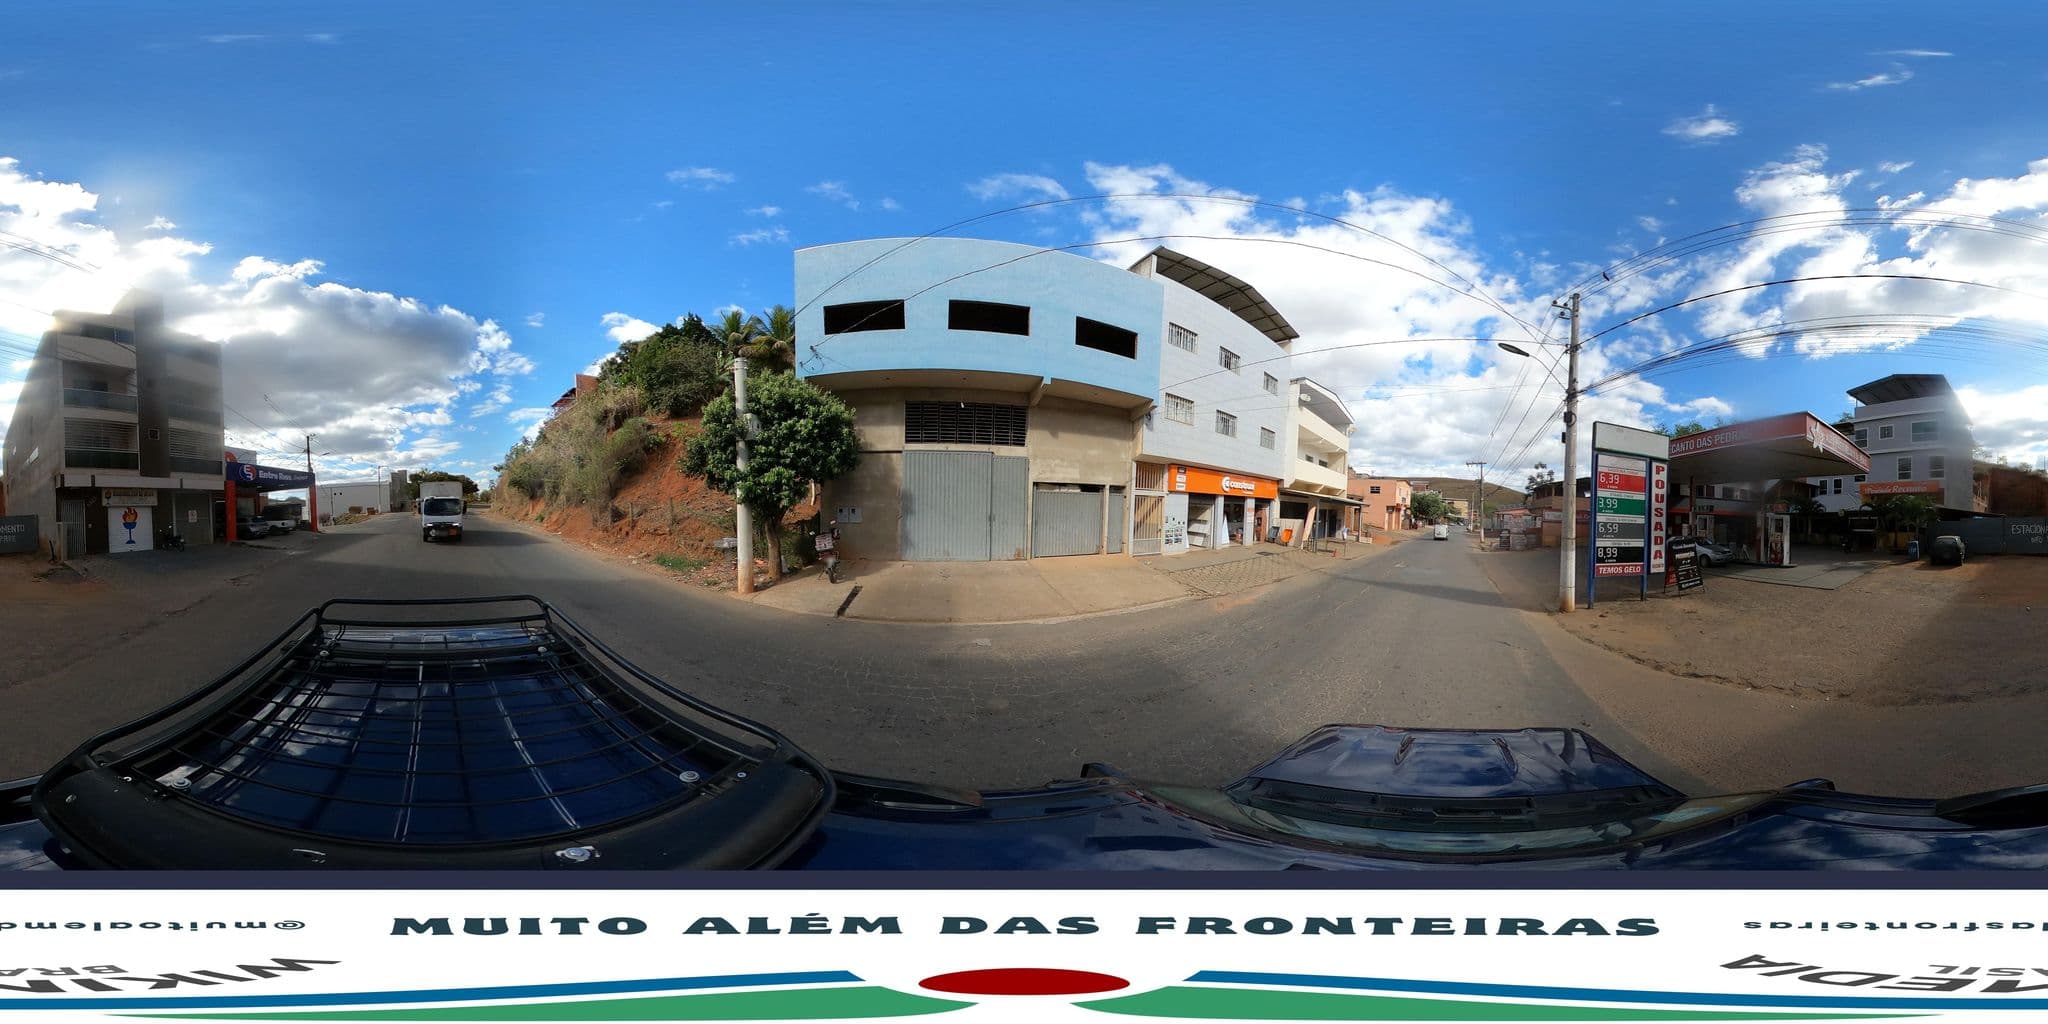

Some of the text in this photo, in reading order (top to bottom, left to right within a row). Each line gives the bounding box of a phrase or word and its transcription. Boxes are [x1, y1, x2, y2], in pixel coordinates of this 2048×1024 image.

[1696, 435, 1713, 449] DAS
[1653, 465, 1665, 560] POUSADA
[1599, 566, 1623, 574] TEMOS
